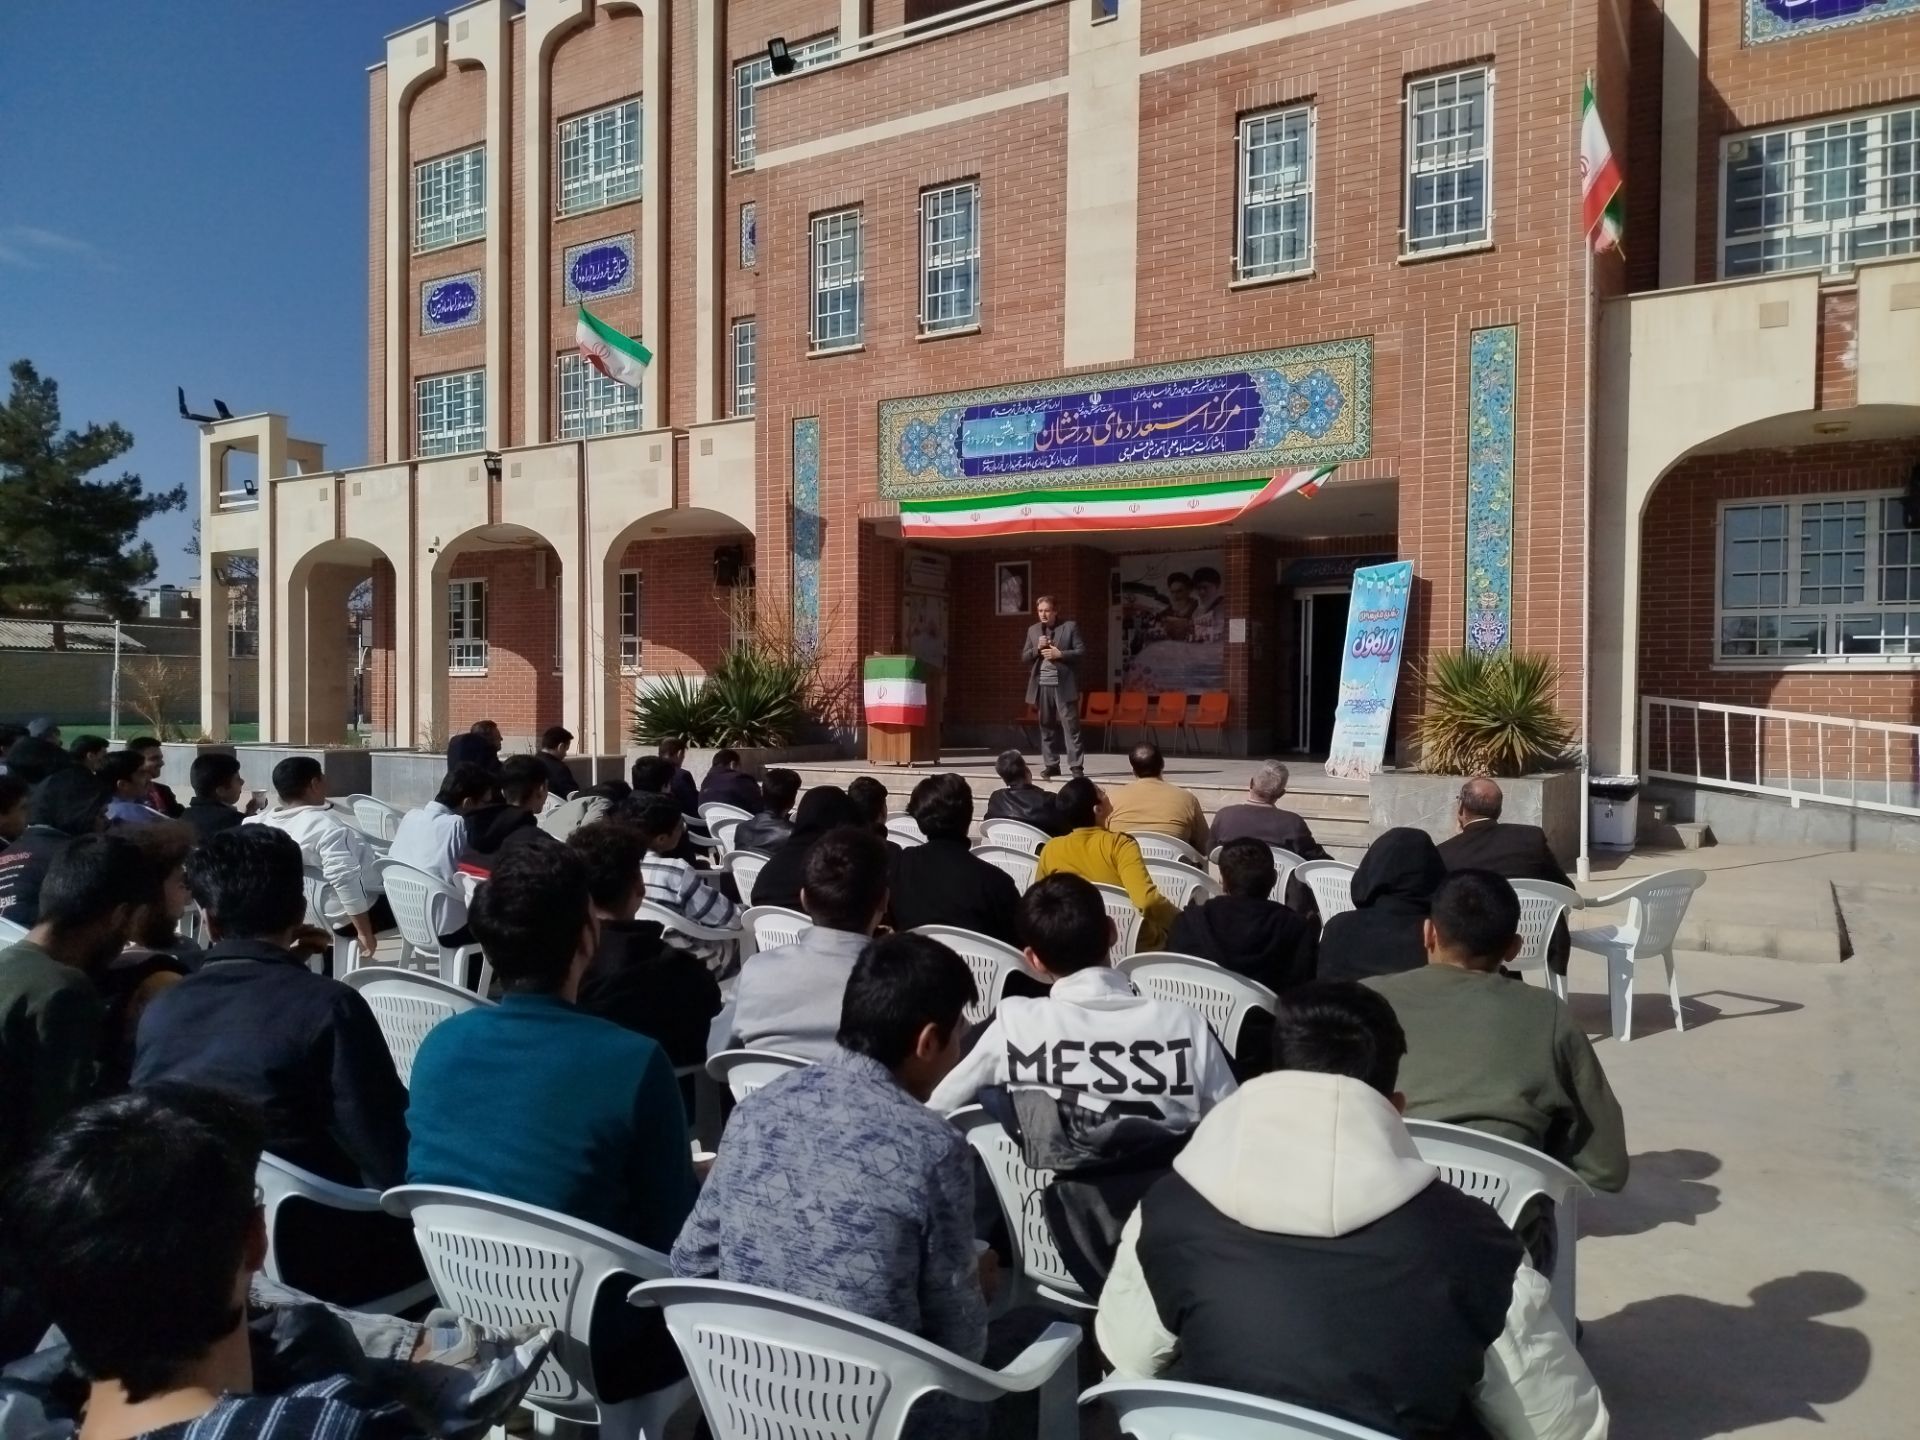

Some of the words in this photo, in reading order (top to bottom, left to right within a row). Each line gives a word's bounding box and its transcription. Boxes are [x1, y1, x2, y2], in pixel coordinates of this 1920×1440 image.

[1132, 388, 1147, 401] رضوی
[1147, 383, 1171, 399] خراسان
[1170, 382, 1186, 397] پرورش
[1188, 378, 1212, 393] آموزش
[1031, 398, 1052, 413] آموزش
[1206, 383, 1241, 436] مرکز
[1014, 418, 1037, 446] شهید
[1035, 411, 1092, 452] درخشان
[1143, 440, 1168, 460] آموزشی
[1163, 439, 1178, 458] علمی
[1175, 438, 1200, 456] بنیاد
[1194, 433, 1221, 452] مشارکت
[1006, 1038, 1195, 1096] MESSI
